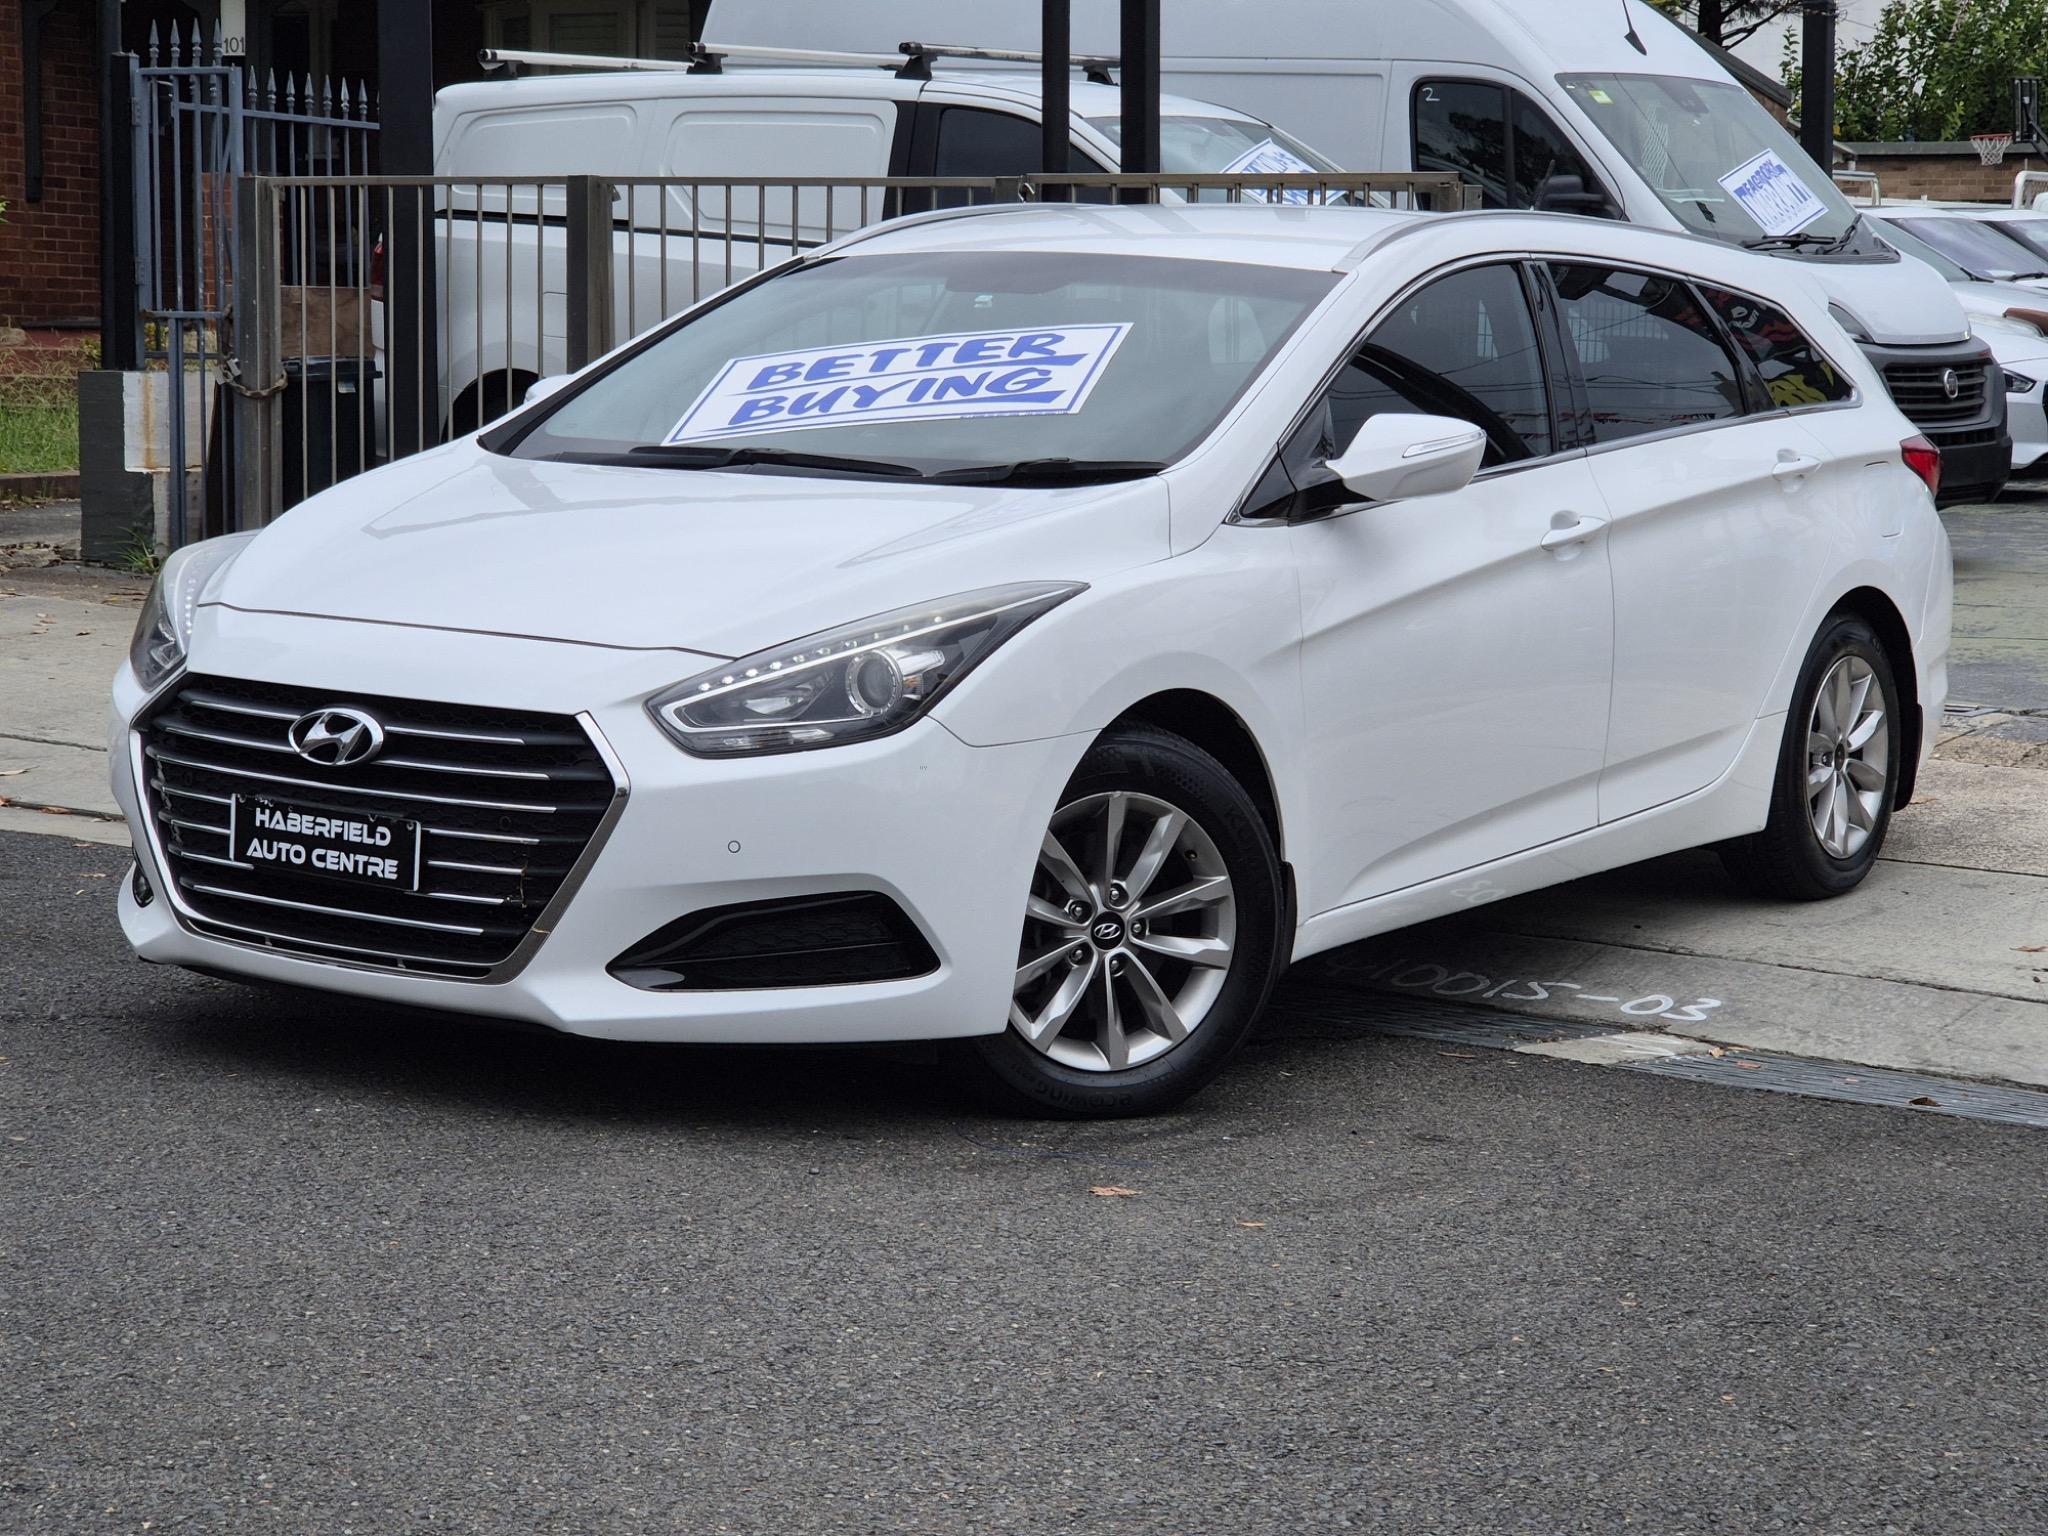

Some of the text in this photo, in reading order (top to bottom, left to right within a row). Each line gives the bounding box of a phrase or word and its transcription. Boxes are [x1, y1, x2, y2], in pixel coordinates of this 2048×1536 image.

[223, 36, 245, 54] 101
[1421, 86, 1441, 102] 2
[746, 332, 1066, 391] BETTER
[727, 367, 1053, 426] BUYING
[255, 807, 391, 847] HABERFIELD
[246, 837, 399, 880] AUTO CENTRE
